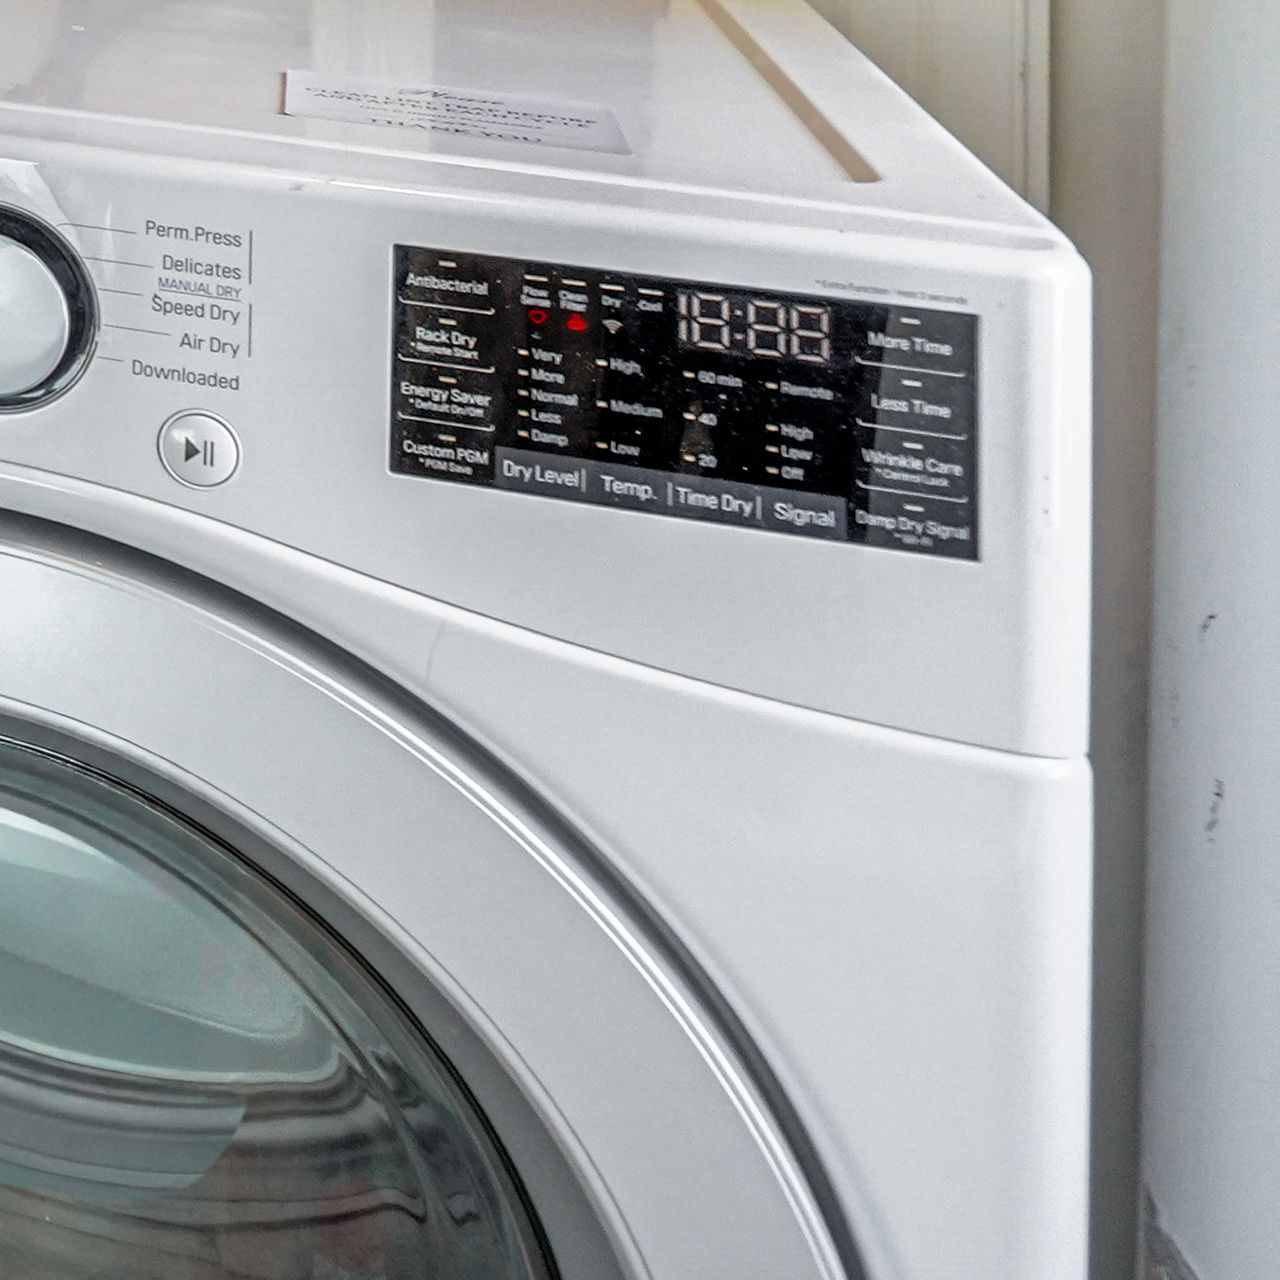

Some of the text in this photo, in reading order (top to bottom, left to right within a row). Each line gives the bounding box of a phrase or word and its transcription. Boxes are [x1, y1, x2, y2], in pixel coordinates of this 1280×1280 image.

[145, 220, 242, 247] Perm.Press
[162, 254, 242, 280] Delicates
[158, 277, 242, 298] MANUAL DRY
[406, 272, 489, 296] Antibacterial
[151, 295, 241, 326] Speed Dry
[179, 333, 240, 359] Air Dry
[415, 326, 477, 349] Rack Dry
[867, 331, 953, 356] More Time
[531, 347, 563, 365] Very
[609, 357, 642, 375] High
[132, 359, 240, 391] Downloaded
[531, 367, 565, 384] More
[400, 381, 492, 407] Energy Saver
[531, 388, 579, 407] Normal
[870, 393, 952, 418] Less Time
[530, 407, 562, 425] Less
[609, 399, 664, 418] Medium
[530, 428, 569, 447] Damp
[780, 423, 814, 441] High
[402, 440, 489, 465] Custom PGM
[610, 440, 641, 456] Low
[780, 444, 814, 461] Low
[503, 459, 580, 487] Dry Level
[861, 447, 964, 477] Wrinkle Care
[600, 475, 657, 501] Temp.
[676, 486, 754, 518] Time Dry
[773, 502, 836, 528] Signal
[855, 509, 970, 540] Damp Dry Signal
